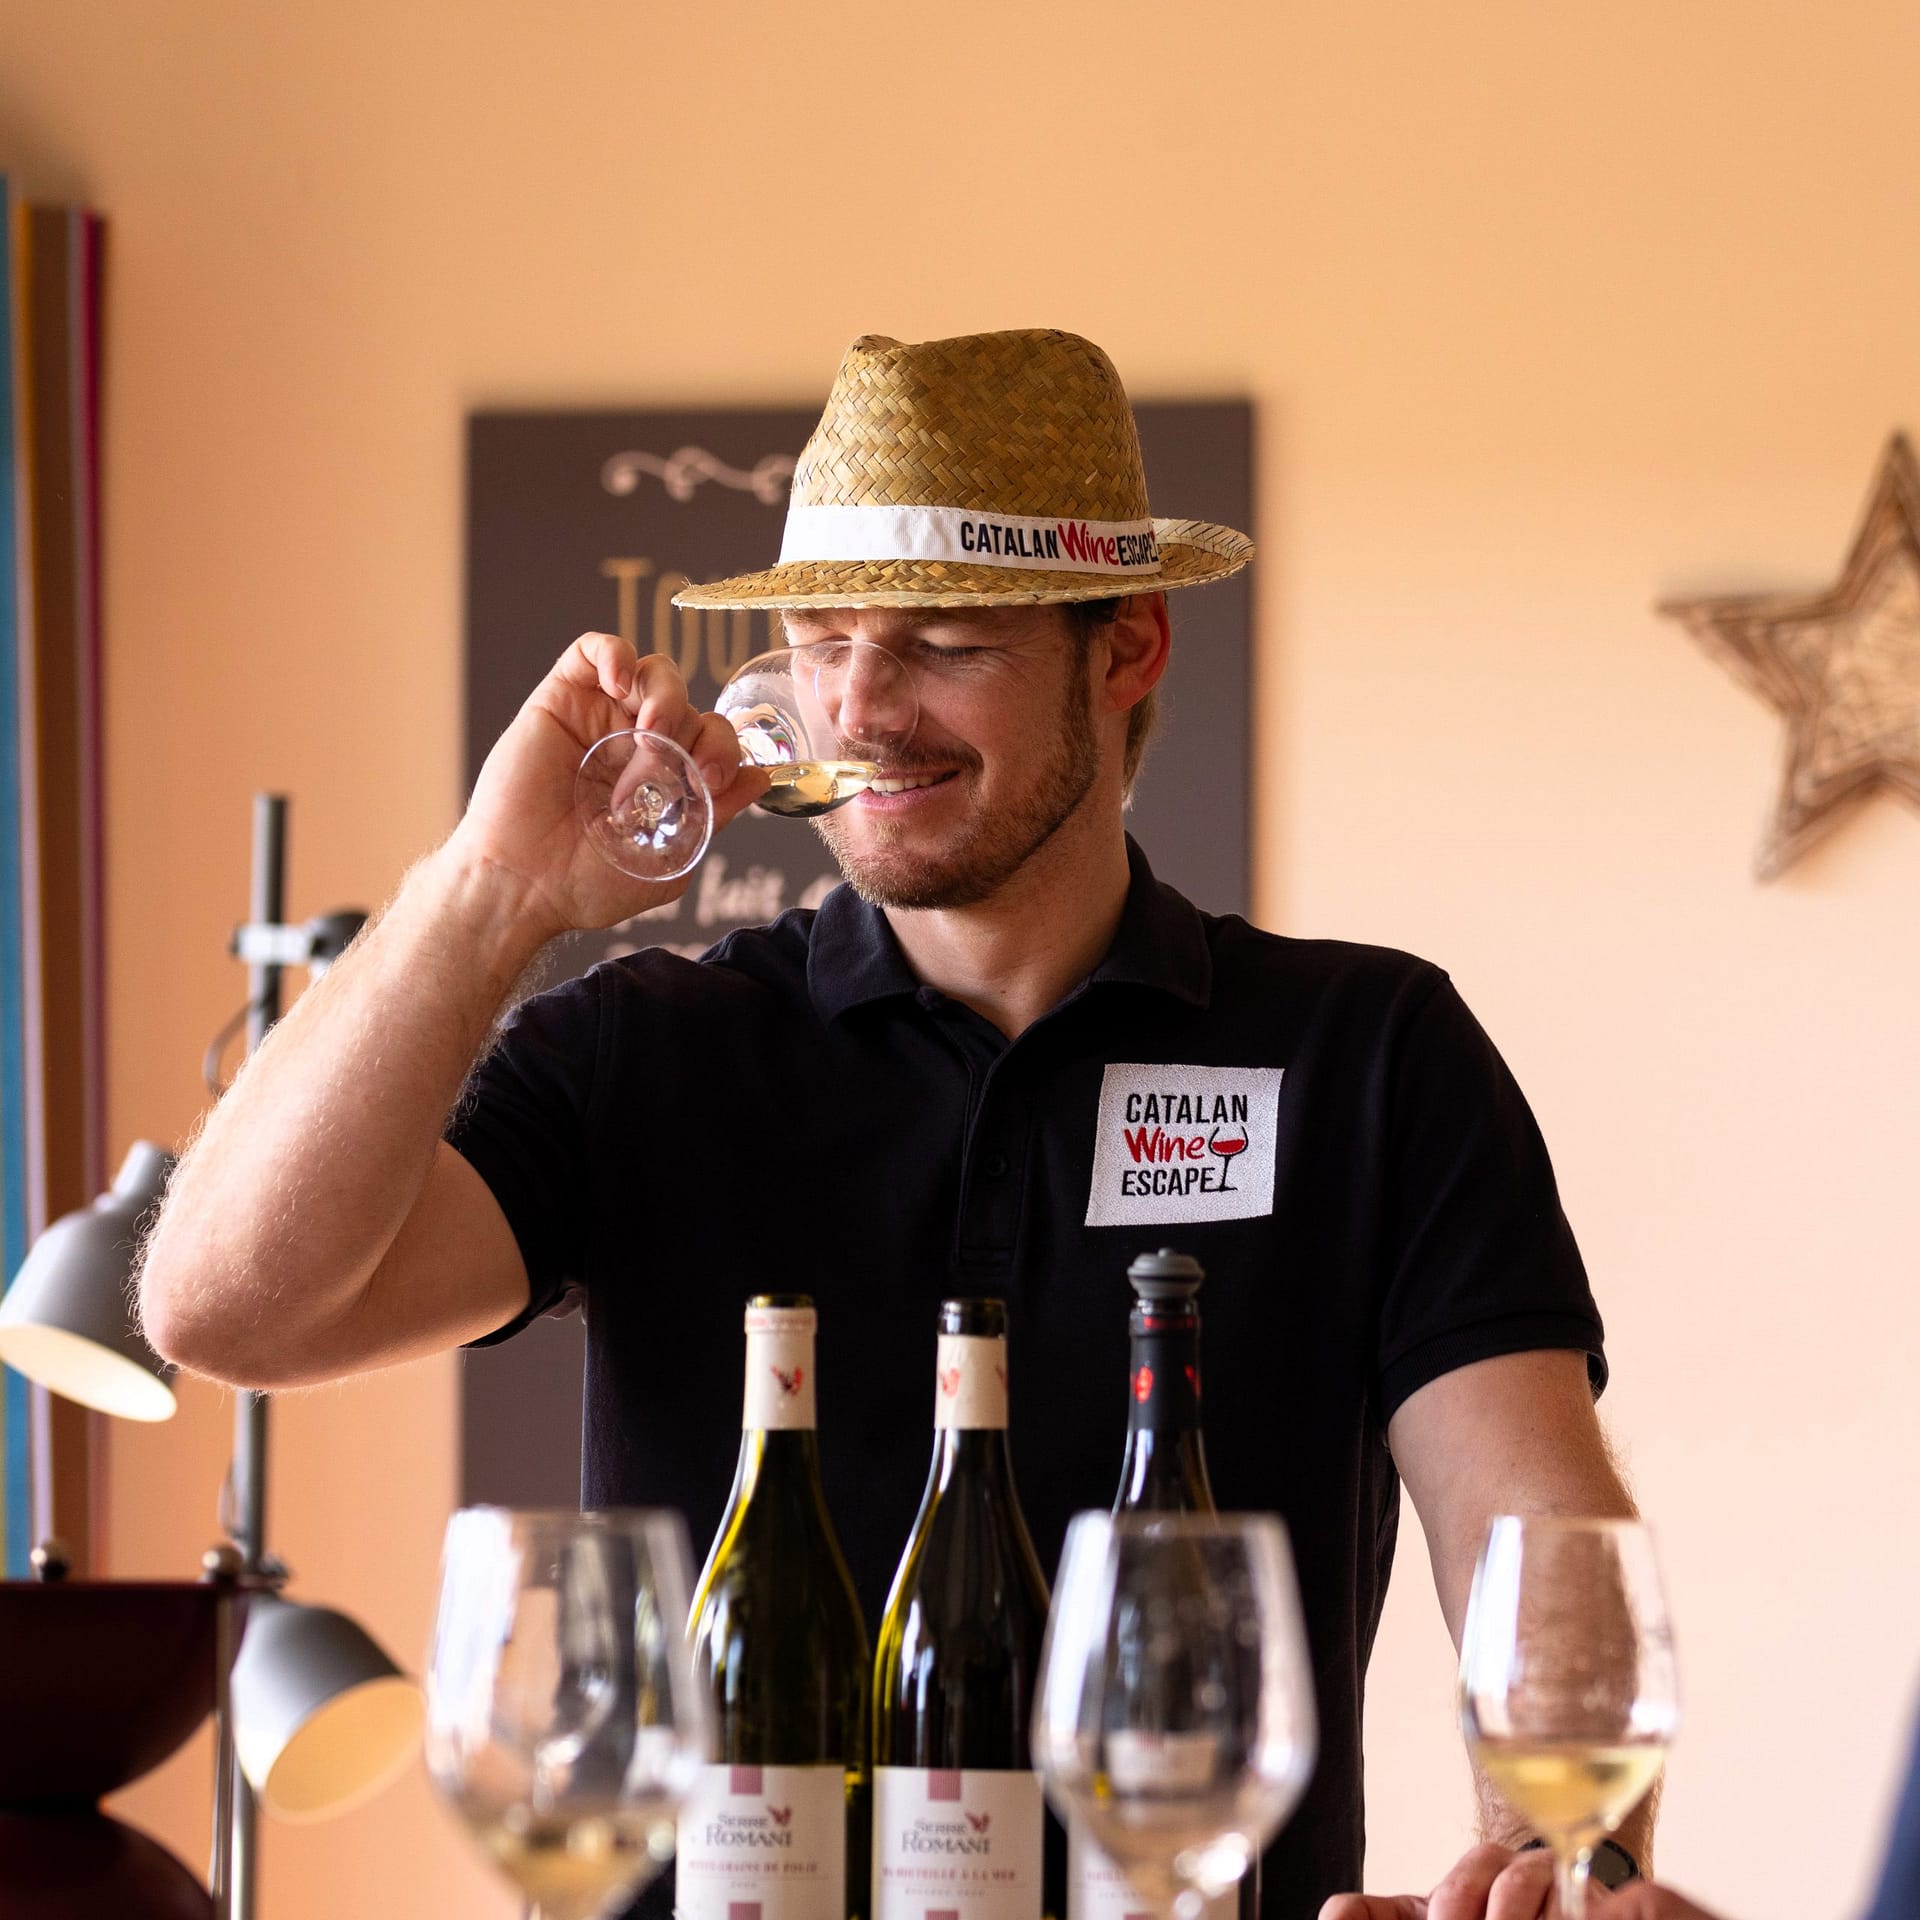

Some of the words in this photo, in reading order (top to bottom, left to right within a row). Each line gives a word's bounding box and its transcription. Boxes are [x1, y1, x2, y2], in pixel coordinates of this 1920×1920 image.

[960, 521, 1060, 559] CATALAN
[1057, 520, 1119, 566] Wine
[1125, 1092, 1248, 1125] CATALAN
[1124, 1126, 1206, 1163] Wine
[1121, 1167, 1217, 1196] ESCAPE
[705, 1823, 793, 1847] ROMANI
[902, 1828, 990, 1855] ROMANI
